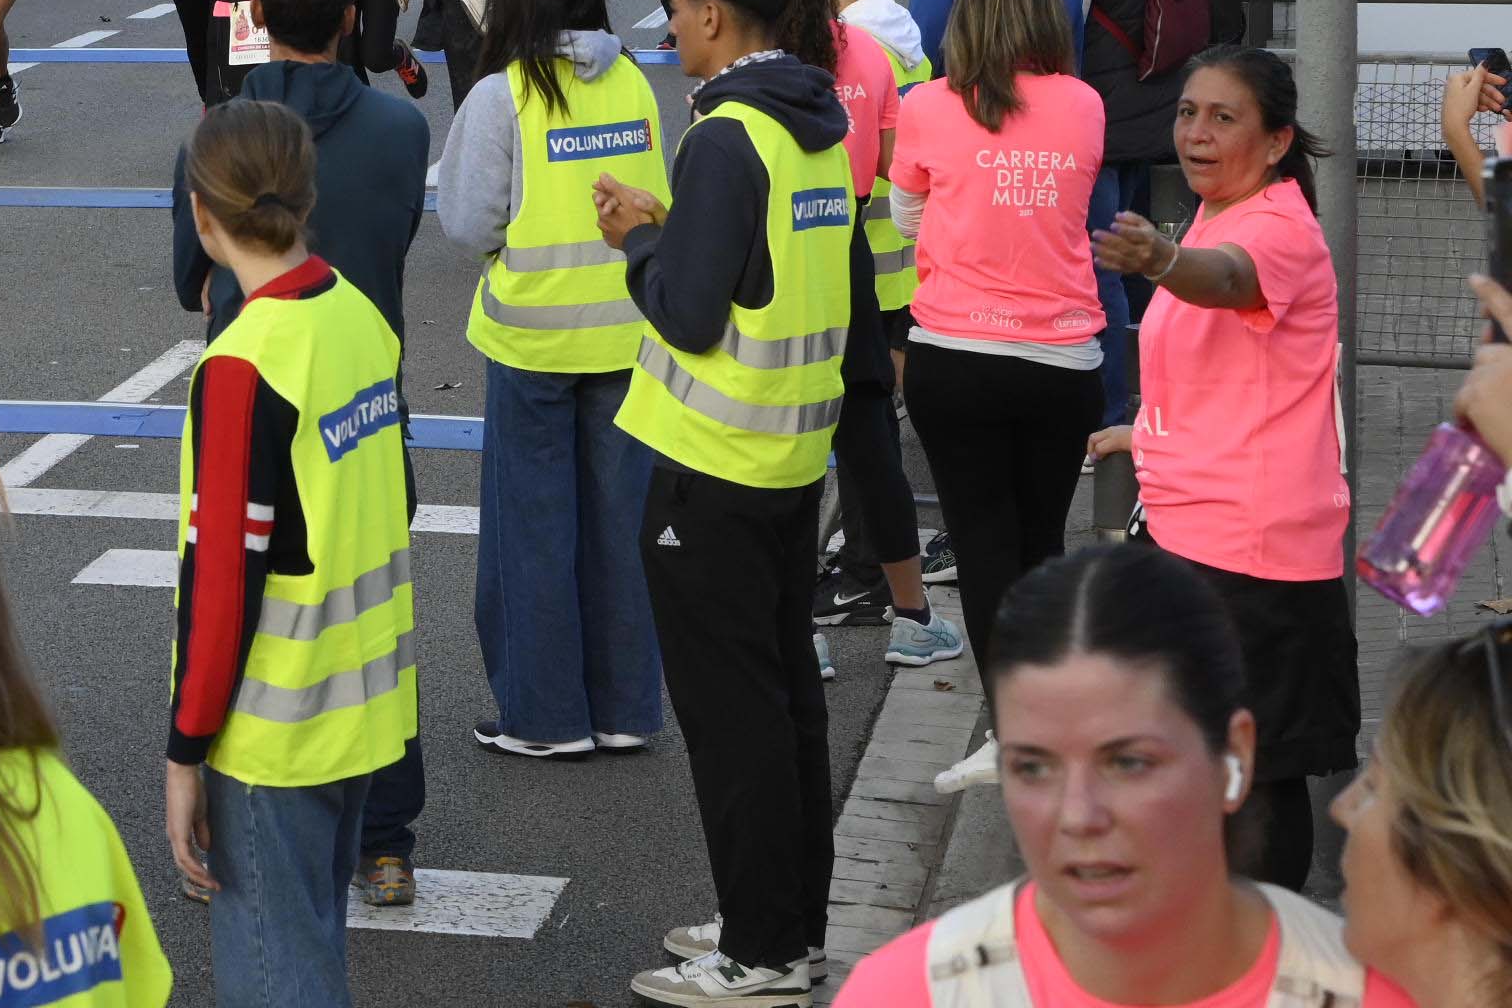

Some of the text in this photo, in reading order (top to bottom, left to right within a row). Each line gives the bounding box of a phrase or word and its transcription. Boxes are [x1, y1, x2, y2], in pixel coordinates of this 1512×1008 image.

[549, 128, 646, 155] VOLUNTARIS
[975, 149, 1077, 171] CARRERA
[997, 169, 1057, 188] DE LA
[991, 189, 1059, 208] MUJER
[970, 309, 1023, 330] OYSHO
[656, 538, 681, 547] adidas
